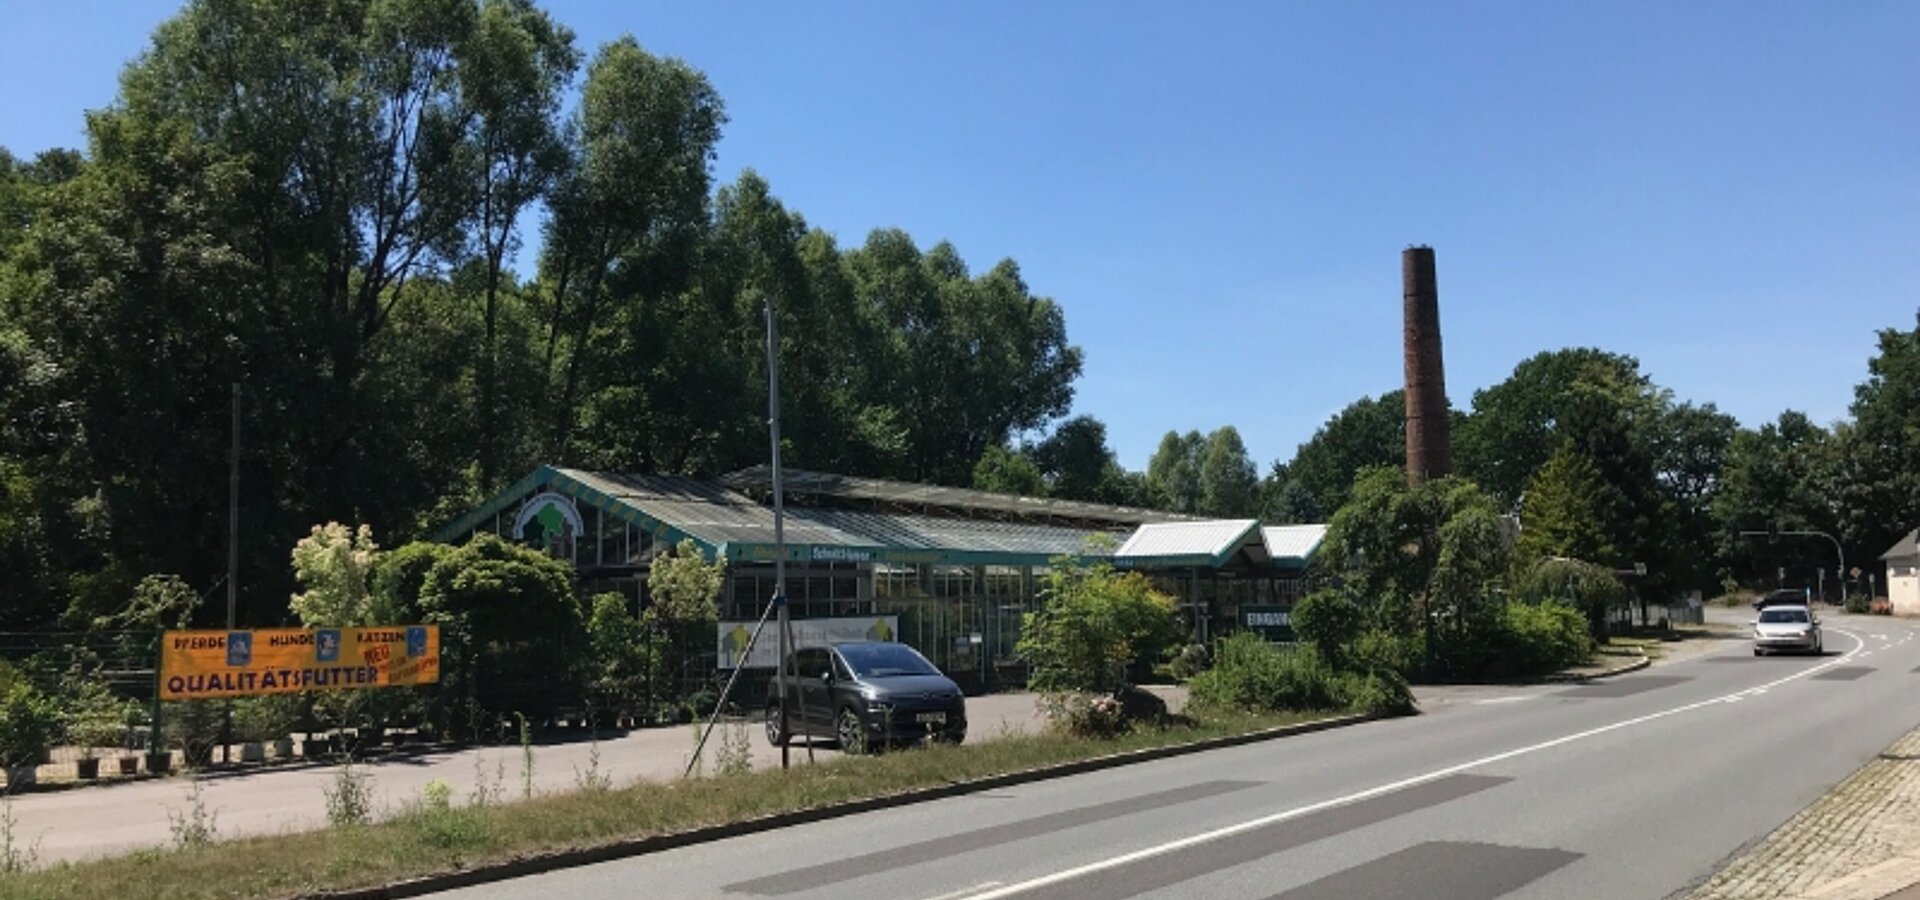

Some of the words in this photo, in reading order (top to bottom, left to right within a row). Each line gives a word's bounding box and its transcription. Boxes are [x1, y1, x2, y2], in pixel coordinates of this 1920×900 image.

[1247, 612, 1291, 626] EINGAN
[174, 636, 226, 650] PFERDE
[270, 634, 315, 647] HUNDE
[357, 631, 405, 643] KATZEN
[364, 644, 390, 667] NEU
[167, 665, 378, 694] QUALITÄTSFUTTER
